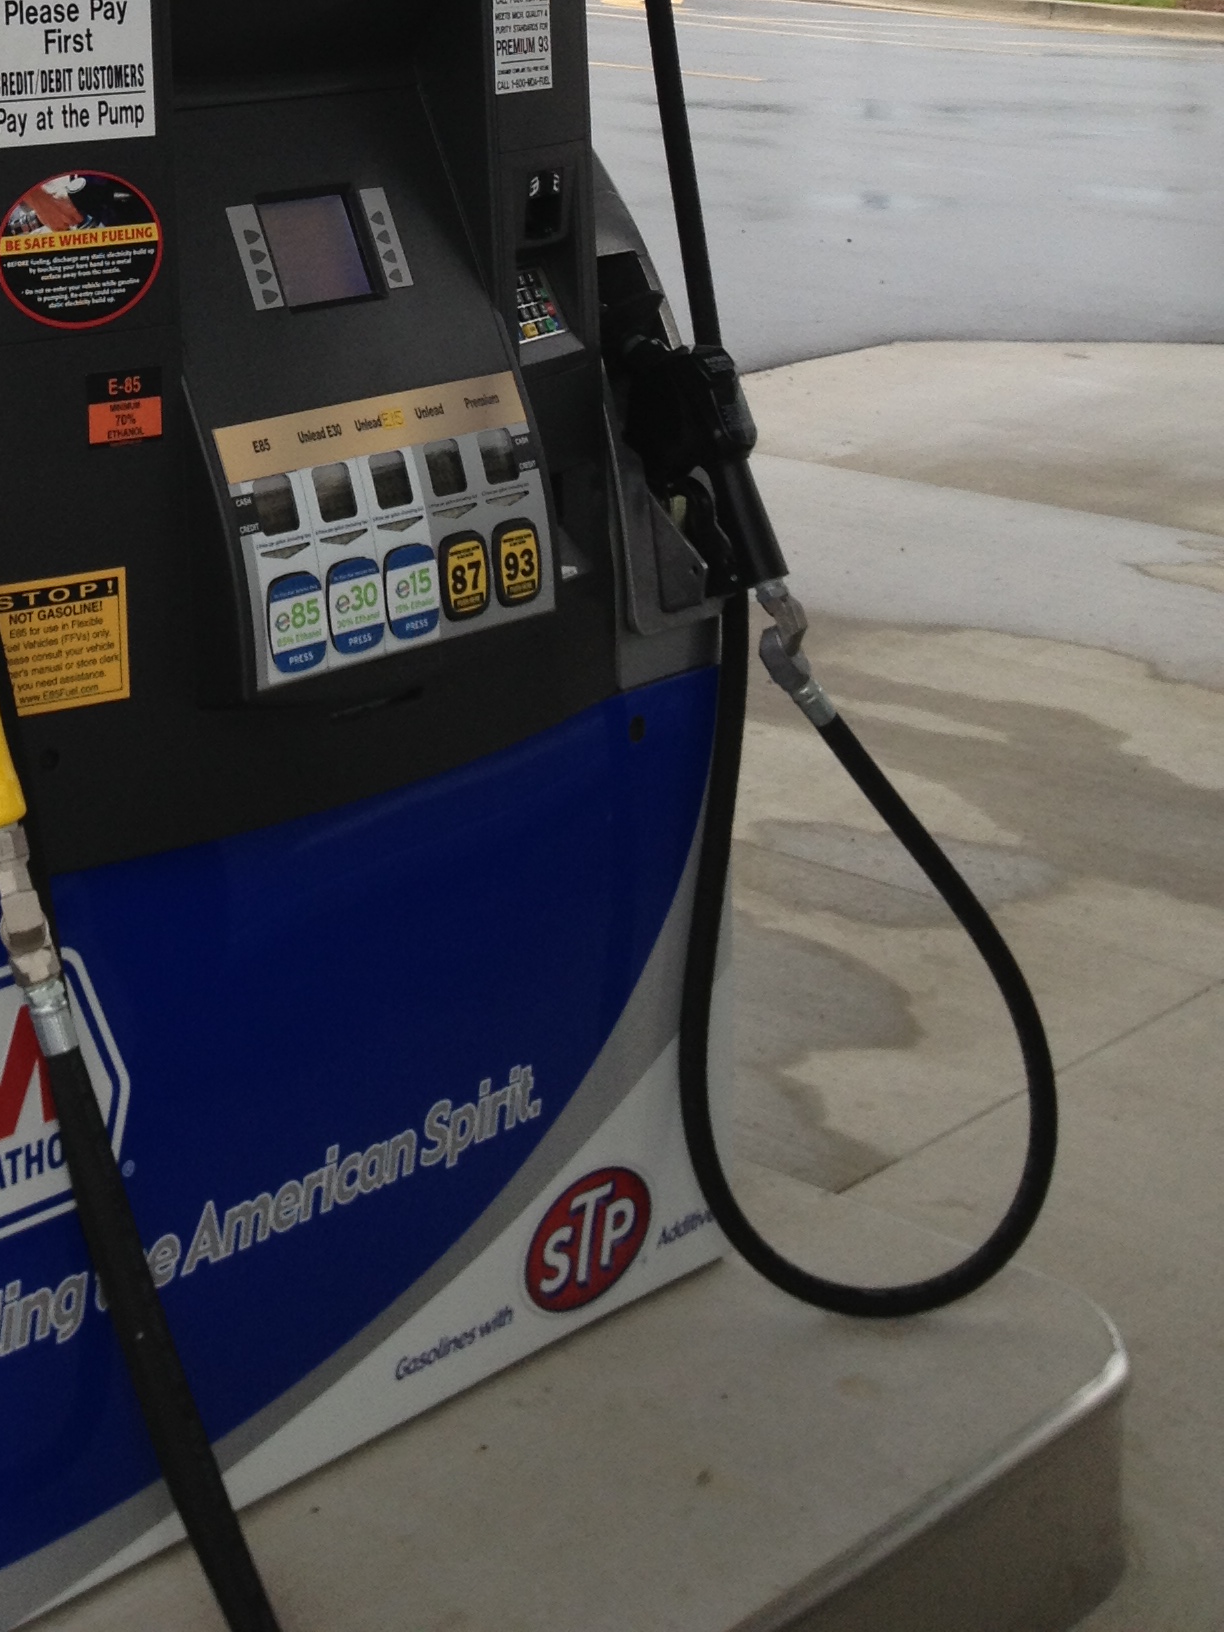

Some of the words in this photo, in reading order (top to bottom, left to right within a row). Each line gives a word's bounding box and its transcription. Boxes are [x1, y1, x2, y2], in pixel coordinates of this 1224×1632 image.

[44, 28, 94, 55] First
[495, 36, 535, 56] PREMIUM
[537, 35, 548, 52] 93
[78, 64, 145, 91] CUSTOMERS
[36, 108, 55, 131] at
[61, 104, 90, 129] the
[97, 100, 145, 129] Pump
[5, 239, 19, 251] BE
[24, 236, 54, 250] SAFE
[58, 231, 97, 246] WHEN
[101, 226, 152, 242] FUELING
[108, 375, 141, 395] E-85
[414, 403, 445, 420] Unlead
[464, 393, 500, 410] Premium
[115, 413, 136, 427] 70%
[354, 417, 382, 433] Unlead
[107, 427, 144, 440] ETHANOL
[297, 427, 326, 445] Unlead
[326, 423, 343, 439] E30
[253, 437, 271, 455] E85
[235, 497, 252, 508] CASH
[239, 522, 260, 535] CREDIT
[504, 548, 535, 581] 93
[395, 568, 432, 600] e15
[451, 560, 482, 595] 87
[335, 581, 378, 615] e30
[9, 610, 33, 625] NOT
[37, 599, 102, 621] GASOLINE!
[276, 597, 320, 633] e85
[354, 610, 380, 626] Ethanol
[29, 625, 39, 635] for
[43, 623, 58, 633] use
[61, 620, 69, 630] in
[71, 615, 103, 629] Flexible
[405, 618, 429, 631] PRESS
[295, 627, 322, 644] Ethanol
[348, 631, 373, 646] PRESS
[31, 649, 62, 662] consult
[65, 646, 83, 658] your
[86, 641, 114, 653] vehicle
[288, 651, 314, 665] PRESS
[31, 662, 62, 675] manual
[64, 661, 73, 670] or
[76, 657, 97, 668] store
[17, 681, 33, 692] you
[35, 677, 57, 688] need
[181, 1130, 416, 1276] American
[421, 1064, 542, 1168] Spirit.
[539, 1180, 637, 1296] STP
[395, 1326, 476, 1381] Gasolines
[479, 1305, 514, 1338] with
